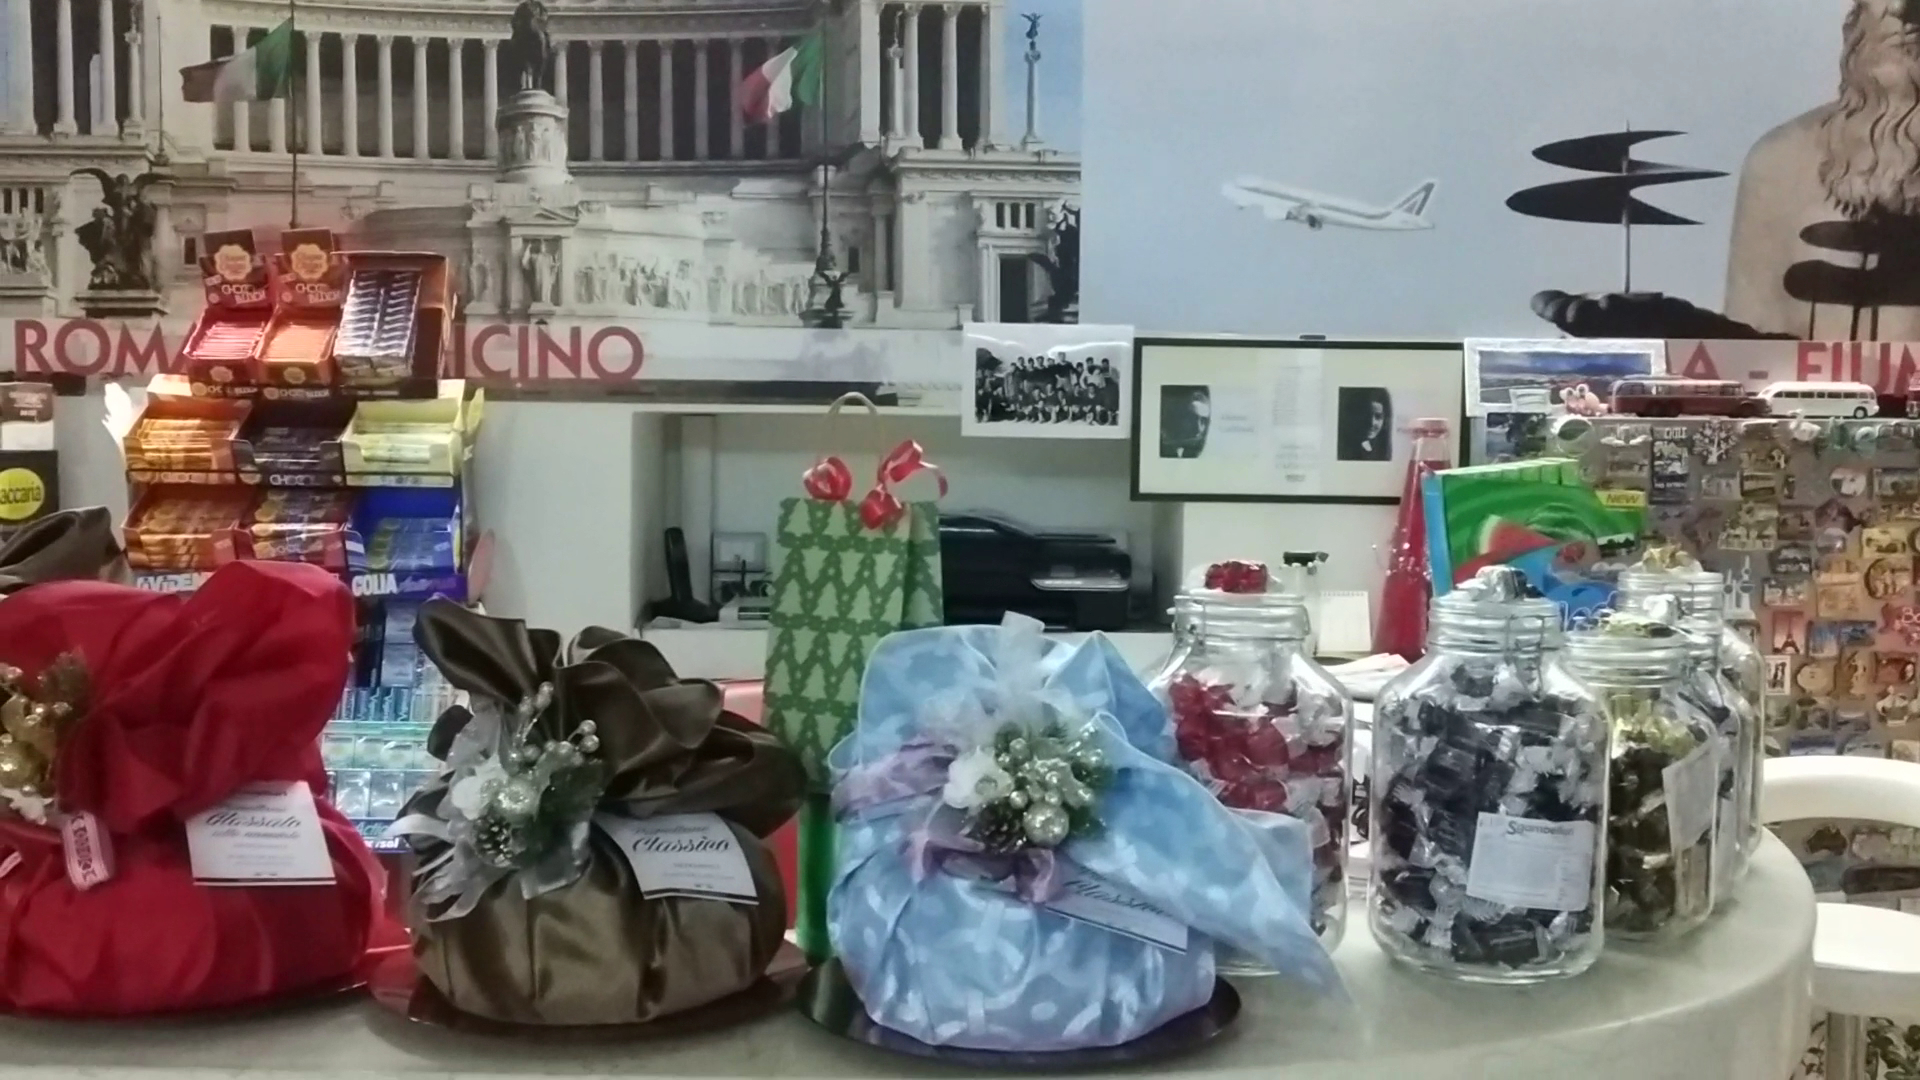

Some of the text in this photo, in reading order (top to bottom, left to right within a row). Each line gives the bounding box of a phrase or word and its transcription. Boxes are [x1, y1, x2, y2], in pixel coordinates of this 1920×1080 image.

[454, 323, 644, 385] ICINO
[1606, 494, 1640, 504] NEW
[632, 835, 730, 853] Classico
